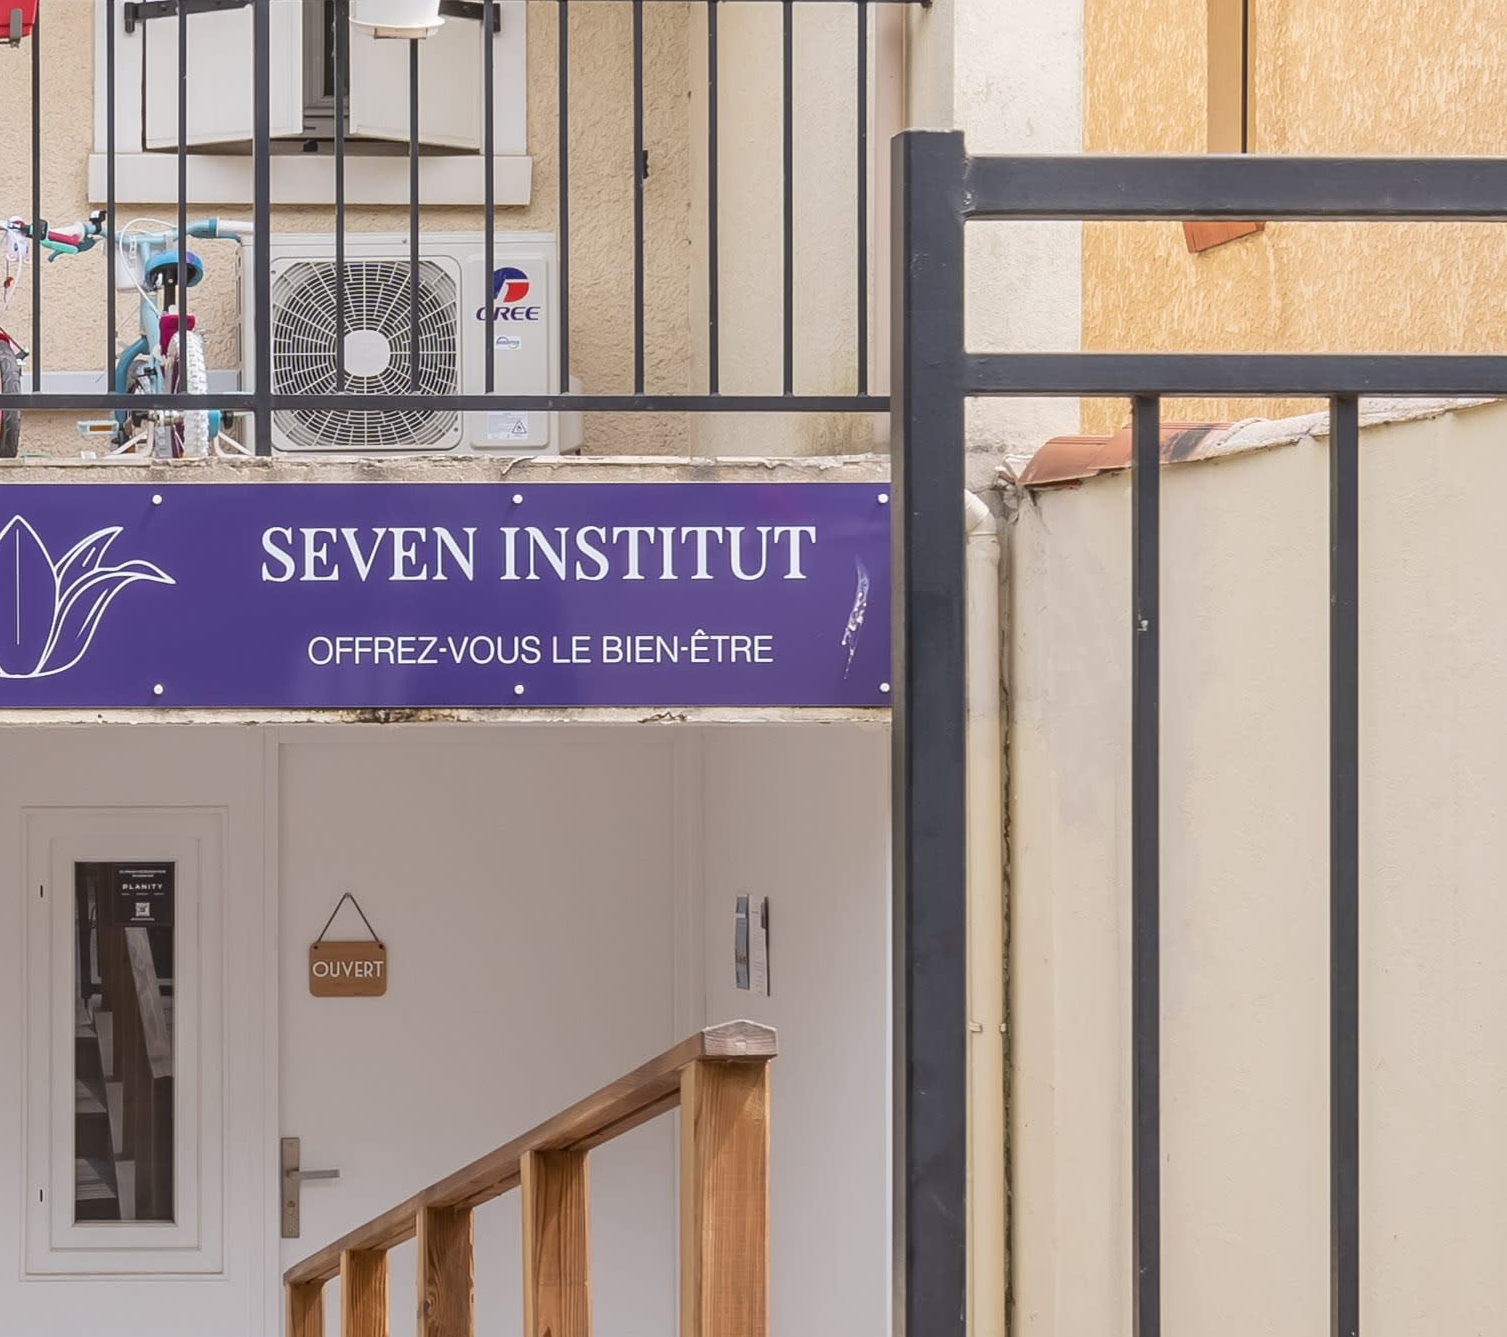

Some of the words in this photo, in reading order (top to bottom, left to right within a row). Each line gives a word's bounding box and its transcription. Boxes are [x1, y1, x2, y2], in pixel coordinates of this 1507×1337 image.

[261, 526, 478, 582] SEVEN
[499, 525, 817, 581] INSTITUT
[308, 635, 541, 665] OFFREZ-VOUS
[552, 635, 592, 664] LE
[602, 628, 774, 663] BIEN-ÊTRE
[312, 960, 384, 978] OUVERT
